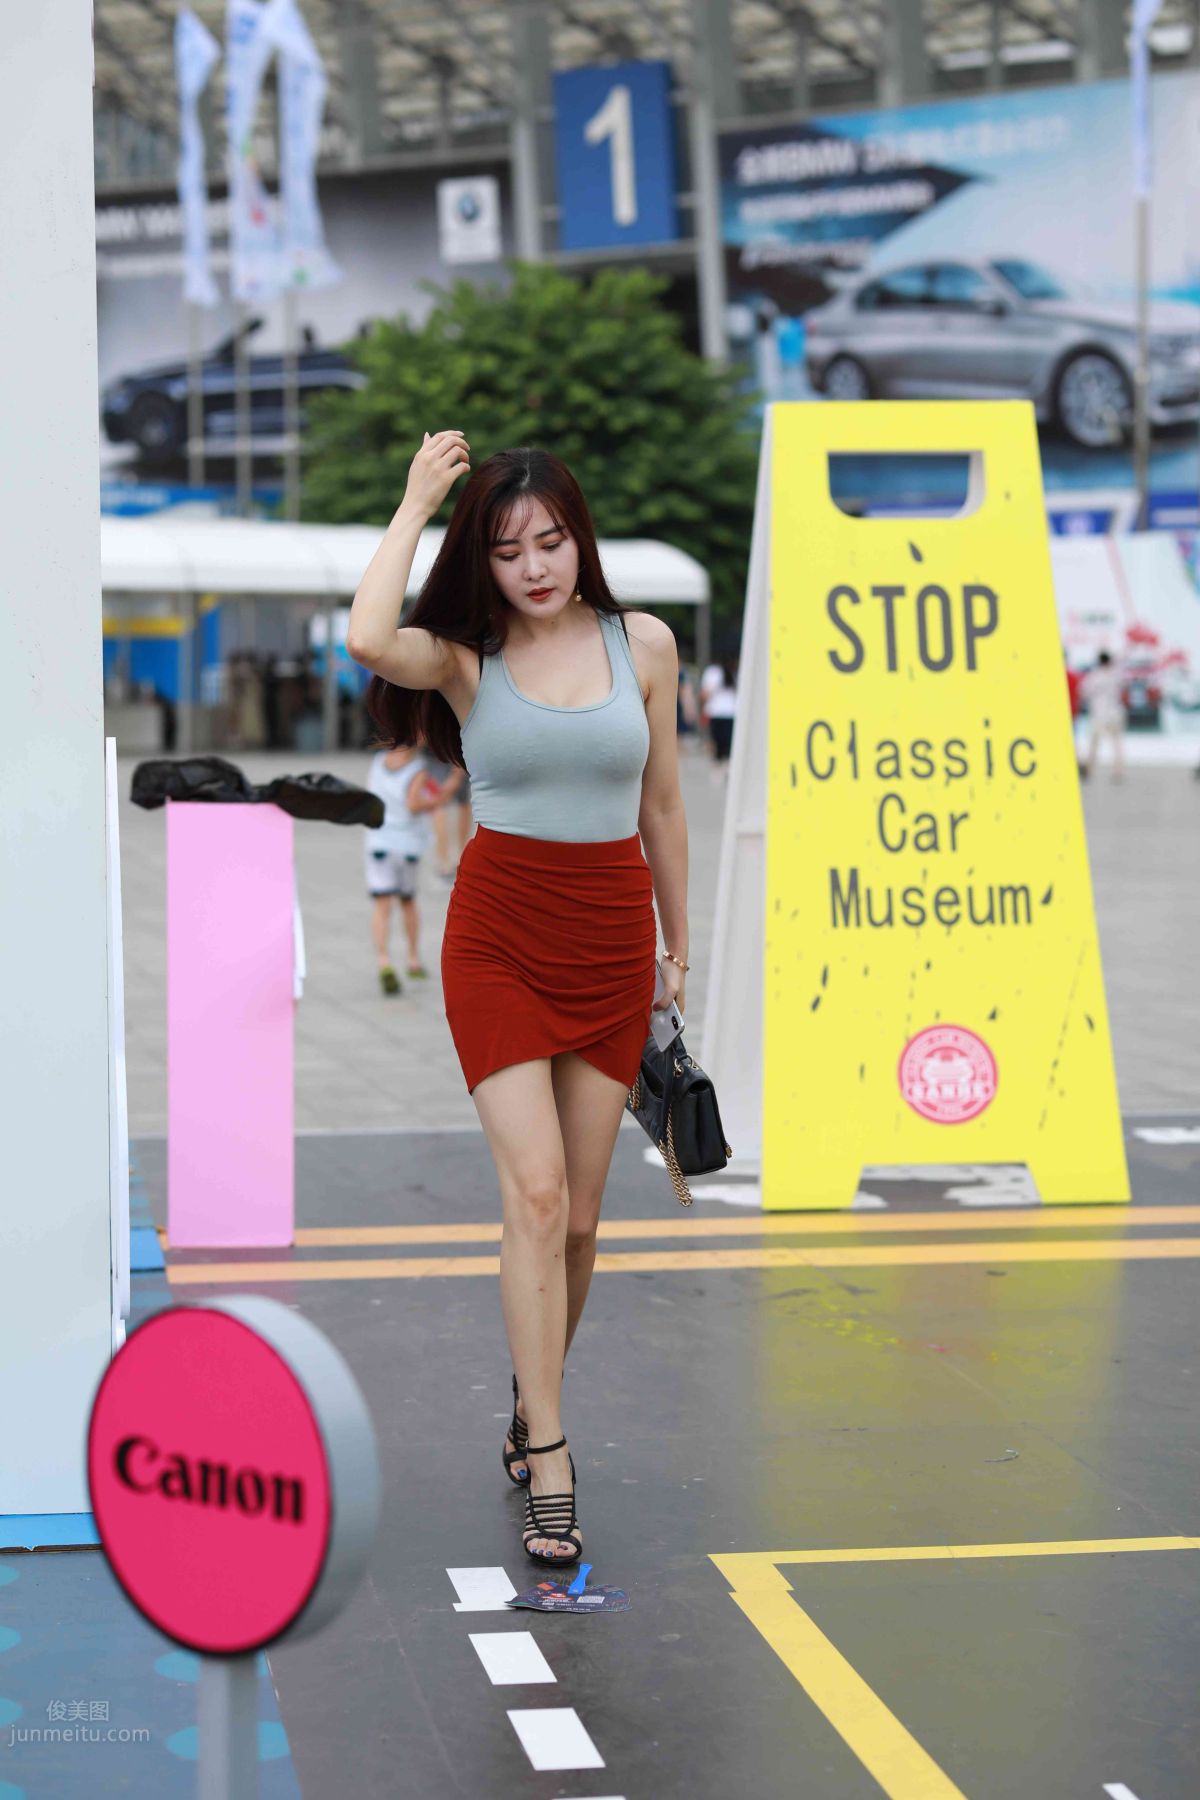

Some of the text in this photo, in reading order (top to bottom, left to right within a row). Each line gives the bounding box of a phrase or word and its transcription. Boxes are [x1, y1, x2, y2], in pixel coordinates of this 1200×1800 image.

[583, 85, 637, 226] 1
[826, 584, 1000, 673] STOP
[806, 719, 1037, 781] Classic
[878, 793, 969, 853] Car
[830, 868, 1032, 928] Museum
[114, 1435, 306, 1526] Canon
